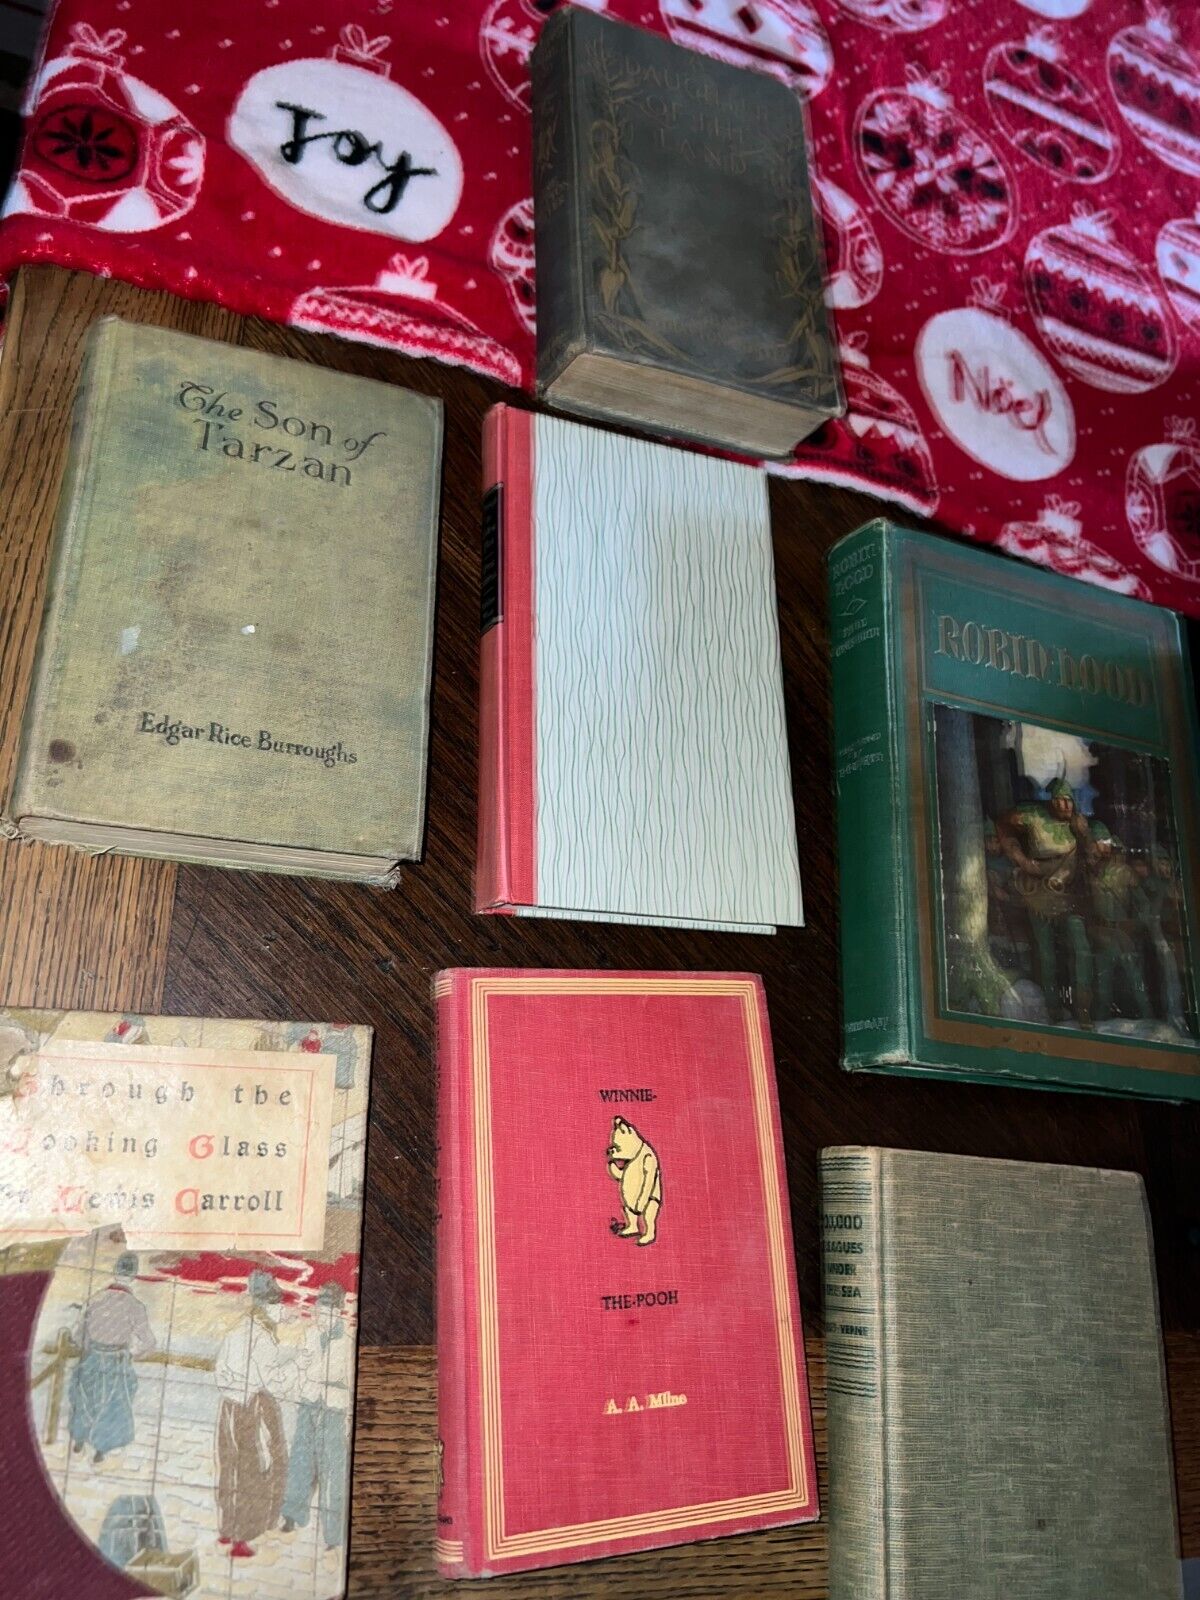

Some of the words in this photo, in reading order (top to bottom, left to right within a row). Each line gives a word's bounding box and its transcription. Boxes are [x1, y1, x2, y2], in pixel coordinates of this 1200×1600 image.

[275, 100, 438, 214] Joy
[179, 380, 244, 422] The
[253, 400, 332, 446] Son
[343, 431, 388, 462] of
[192, 418, 353, 487] Tarzan
[934, 614, 1051, 683] ROBIN
[139, 711, 205, 746] Edgar
[207, 722, 252, 748] Rice
[256, 729, 358, 768] Burroughs
[233, 1083, 293, 1106] the
[188, 1134, 288, 1160] Glass
[175, 1188, 284, 1217] Carroll
[841, 1285, 862, 1298] SEA
[646, 1390, 688, 1409] Milne
